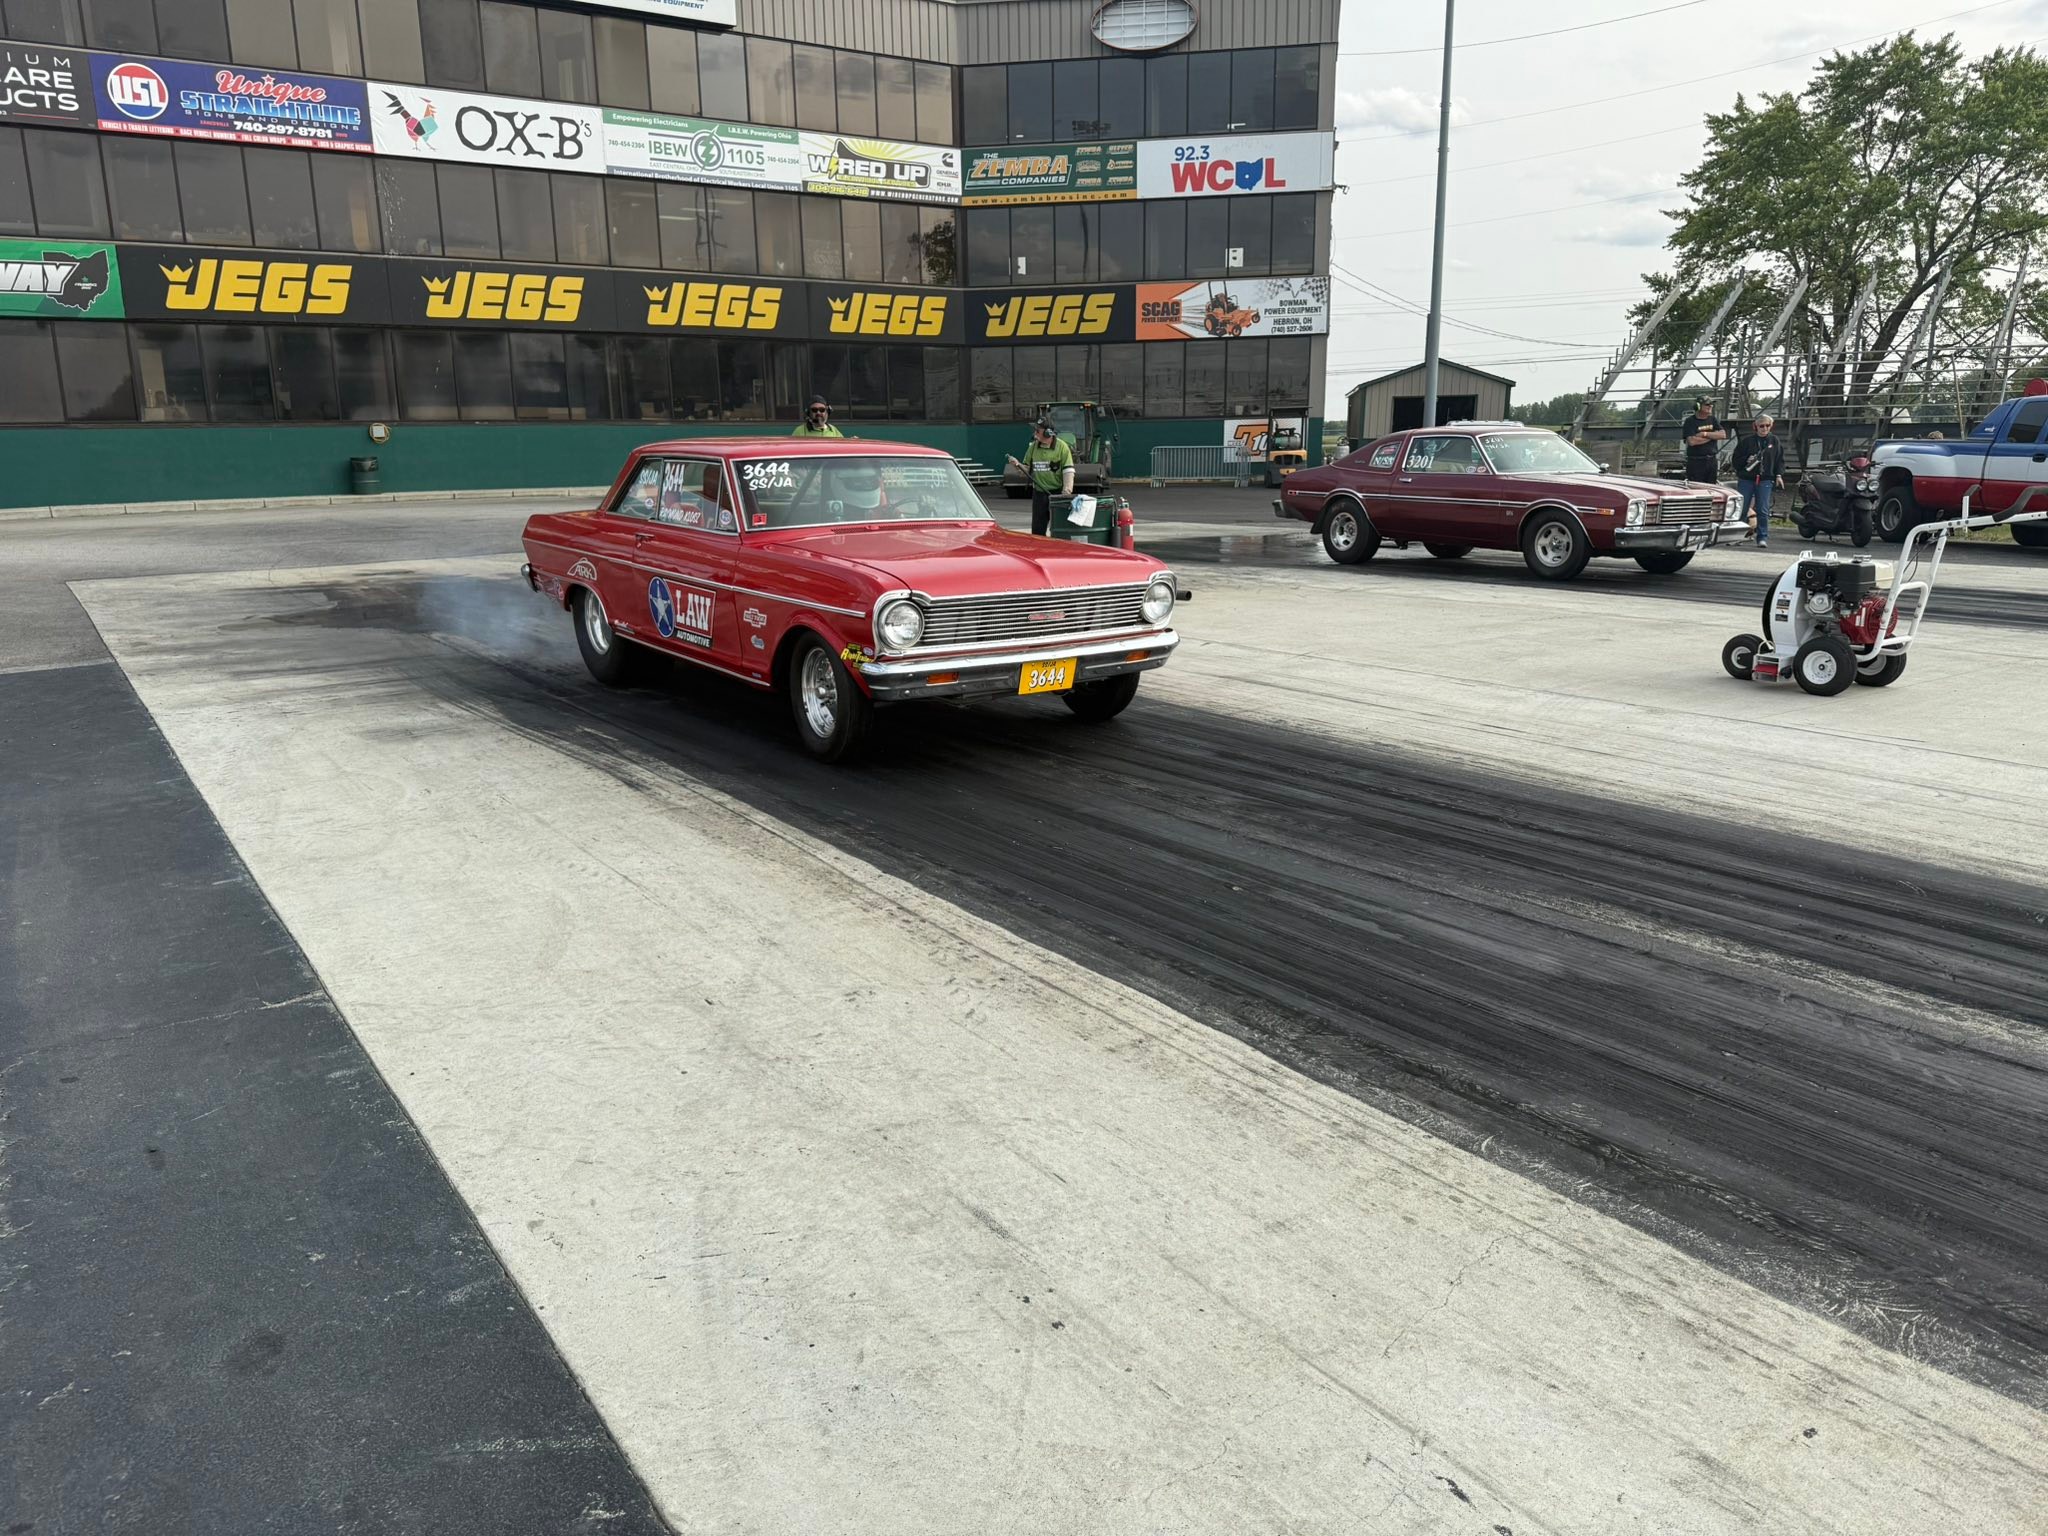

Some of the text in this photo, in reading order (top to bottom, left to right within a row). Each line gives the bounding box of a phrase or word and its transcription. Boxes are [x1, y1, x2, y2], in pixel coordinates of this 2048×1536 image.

[0, 66, 75, 90] ARE
[216, 70, 327, 106] Unique
[111, 74, 165, 108] USL
[181, 91, 361, 126] STRAIGHTLINE
[185, 109, 360, 131] SIGNS AND DESIGNS
[233, 120, 332, 139] 740-297-8781
[613, 113, 688, 128] Empowering Electricians
[750, 129, 777, 139] Powering
[778, 132, 791, 140] Ohio
[648, 140, 765, 166] IBEW 1105
[1174, 146, 1210, 162] 92.3
[893, 163, 928, 182] UP
[971, 154, 1070, 180] ZEMBA
[613, 168, 654, 178] International
[654, 172, 693, 182] Brotherhood
[700, 177, 727, 186] Electrical
[727, 179, 751, 188] Workers
[751, 181, 766, 189] Local
[1001, 175, 1067, 186] COMPANIES
[164, 257, 353, 315] JEGS
[423, 271, 585, 322] JEGS
[645, 281, 783, 330] JEGS
[1142, 301, 1181, 318] SCAG
[1264, 306, 1322, 315] POWER EQUIPMENT
[1279, 299, 1308, 307] BOWMAN
[828, 292, 948, 336] JEGS
[984, 292, 1116, 338] JEGS
[1273, 317, 1312, 326] HEBRON, OH
[743, 462, 790, 480] 3644
[1406, 455, 1435, 469] 3201
[663, 462, 685, 493] 3644
[749, 476, 793, 491] SS/JA
[676, 589, 711, 632] LAW
[677, 630, 711, 648] AUTOMOTIVE
[1029, 667, 1065, 689] 3644
